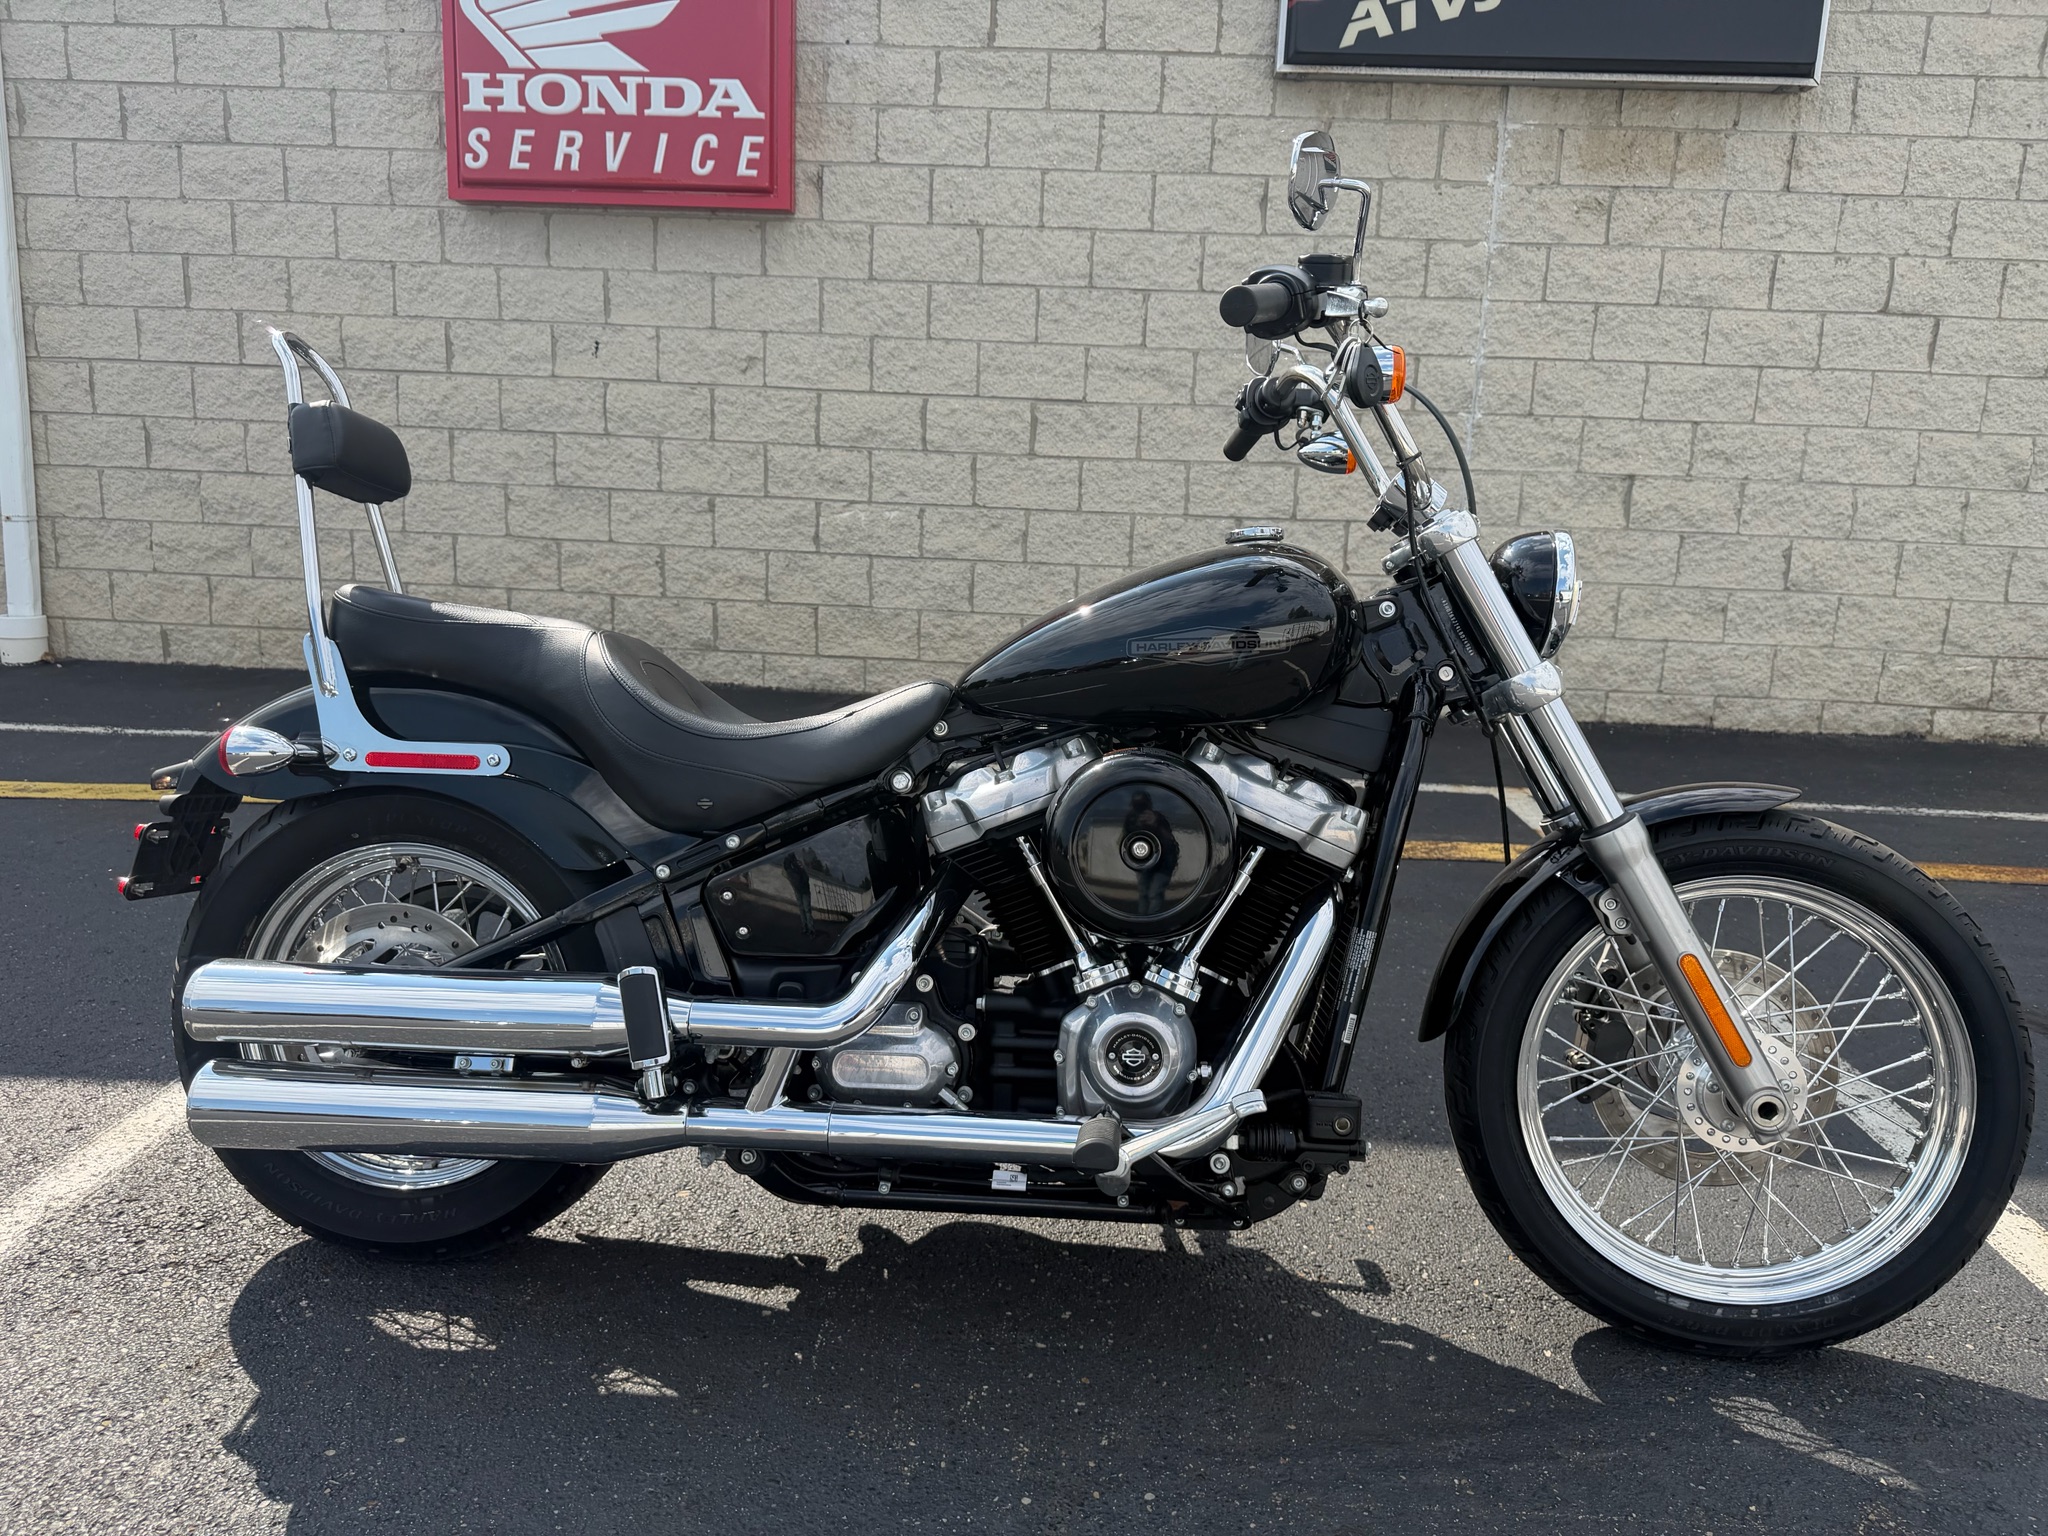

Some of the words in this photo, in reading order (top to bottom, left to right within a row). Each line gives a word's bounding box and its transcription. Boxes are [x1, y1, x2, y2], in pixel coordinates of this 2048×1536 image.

[1339, 0, 1501, 49] ATV
[461, 72, 766, 120] HONDA
[464, 127, 766, 178] SERVICE
[1662, 845, 1837, 868] EY-DAVIDSON
